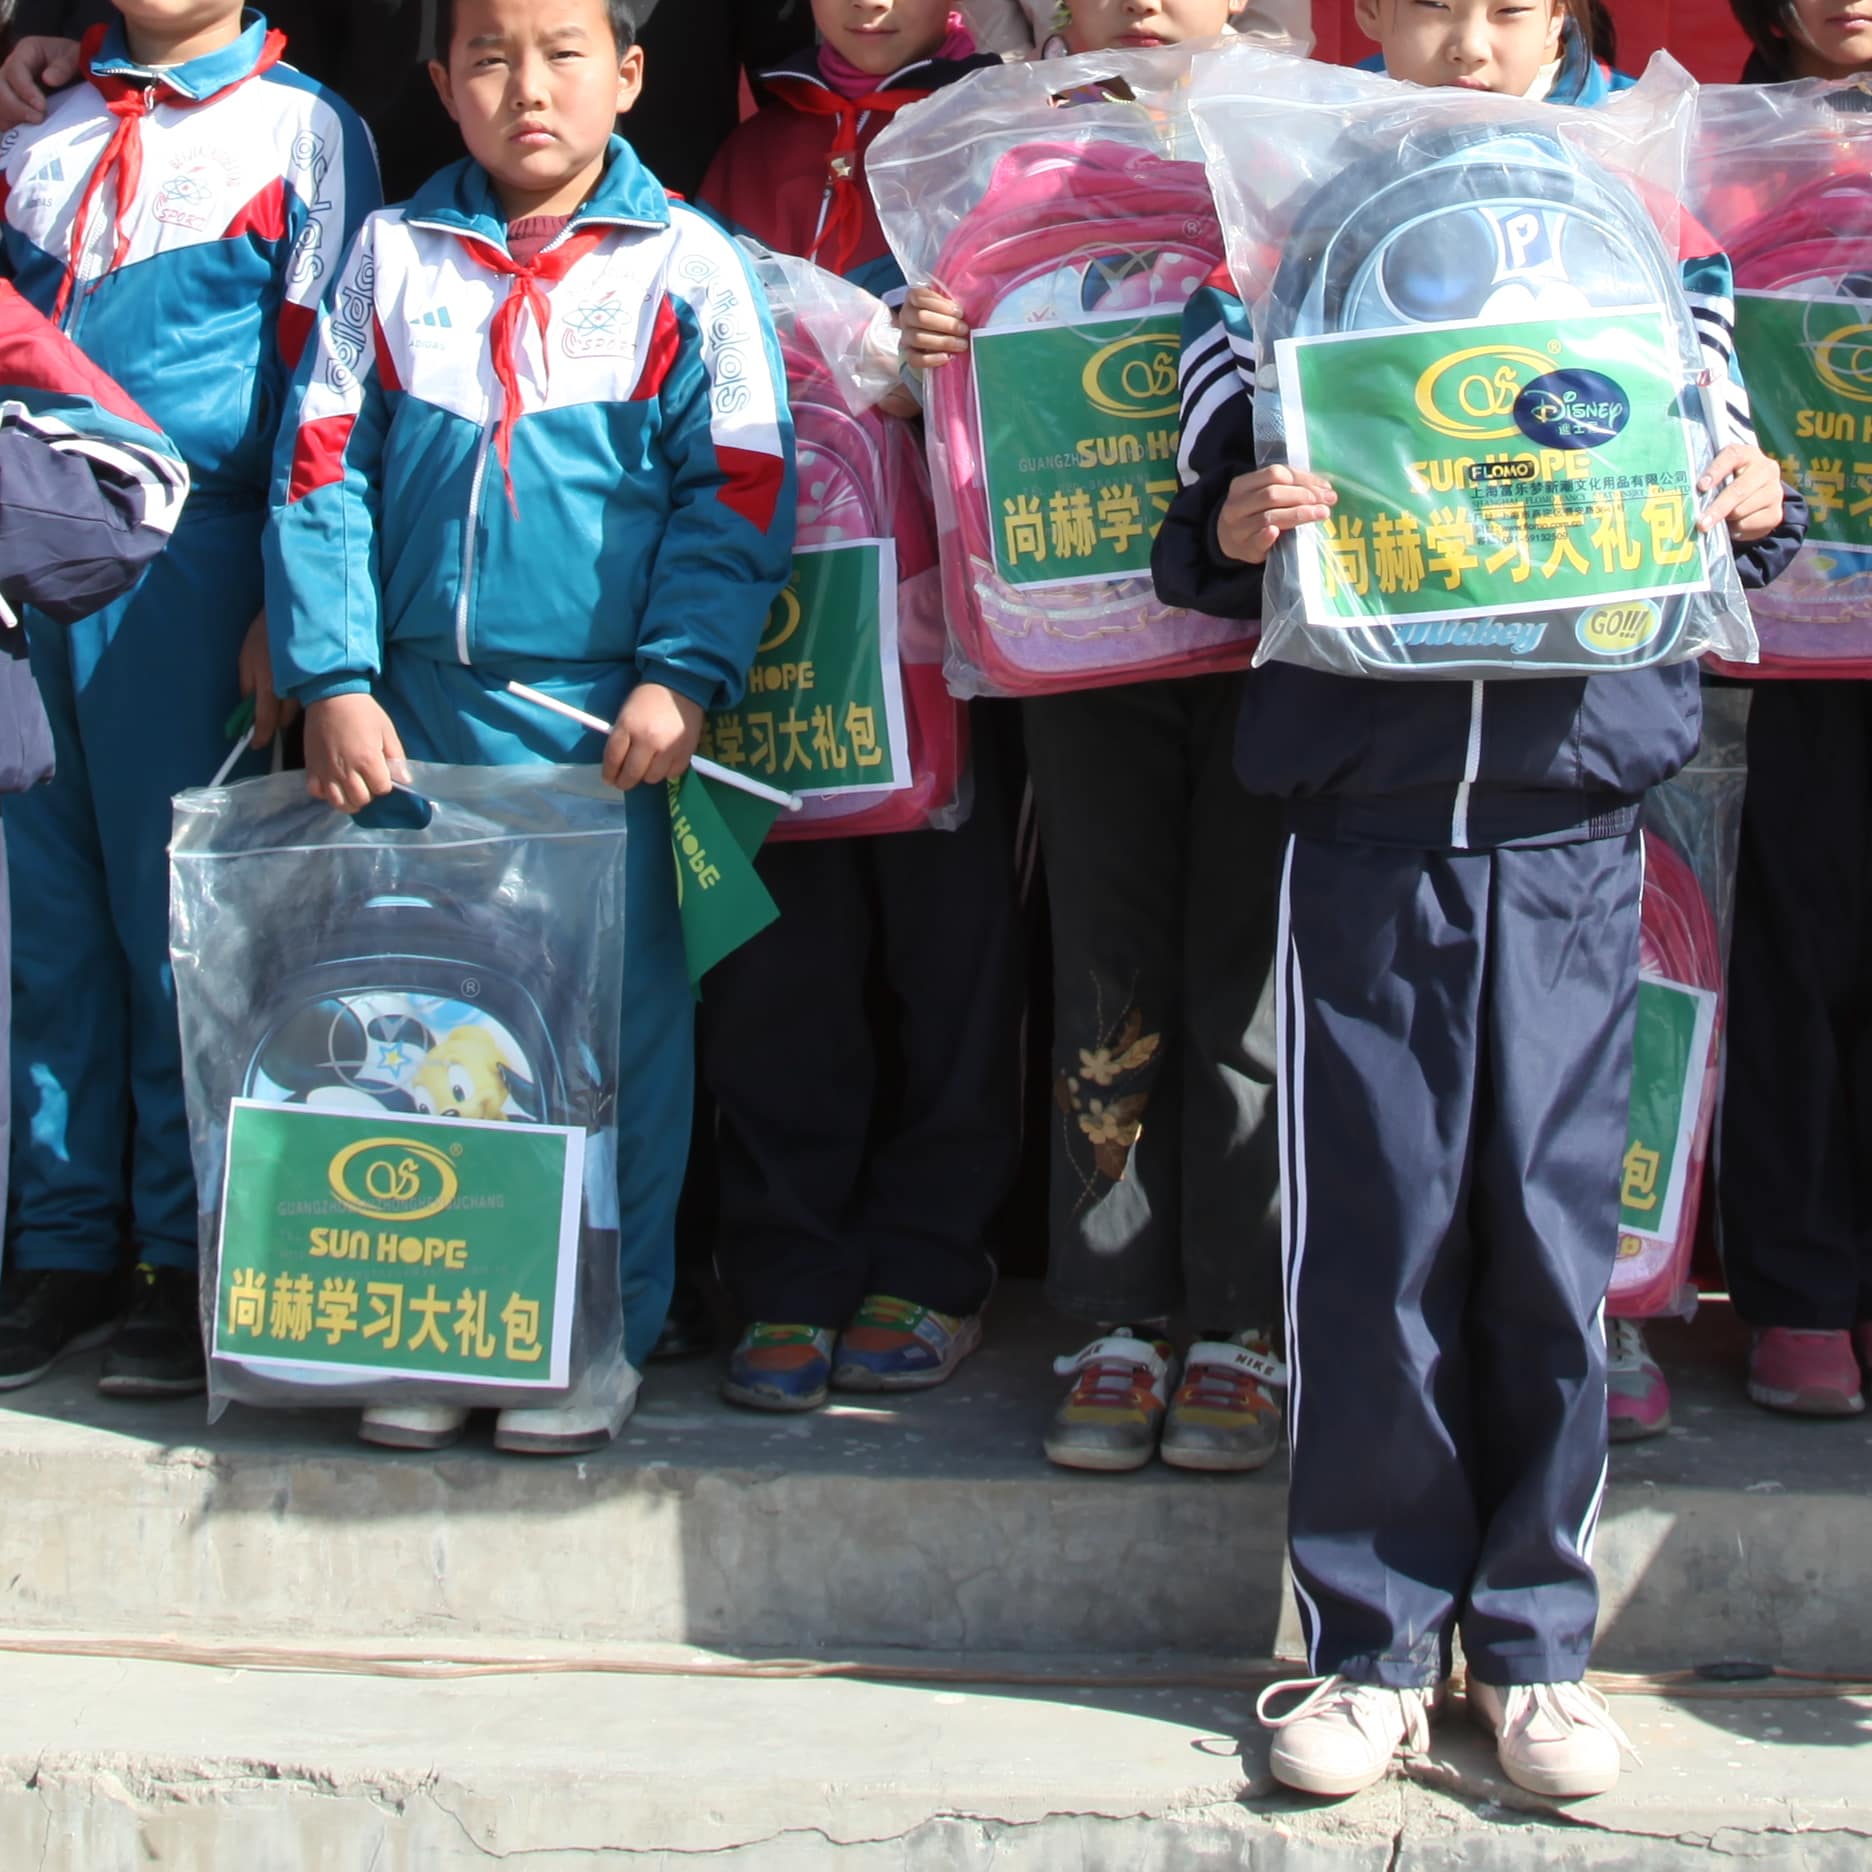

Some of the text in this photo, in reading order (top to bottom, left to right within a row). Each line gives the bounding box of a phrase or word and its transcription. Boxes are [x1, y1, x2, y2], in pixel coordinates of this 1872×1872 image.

[1795, 409, 1856, 442] SUN
[1076, 433, 1141, 470] SUN
[1324, 491, 1696, 598] 尚赫学习大礼包
[1591, 609, 1648, 640] GO!!!
[750, 660, 817, 695] HOPE
[703, 700, 884, 776] 学习大礼包
[308, 1226, 469, 1270] SUN HOPE
[227, 1266, 544, 1363] 尚赫学习大礼包
[1234, 1352, 1276, 1377] NIKE
